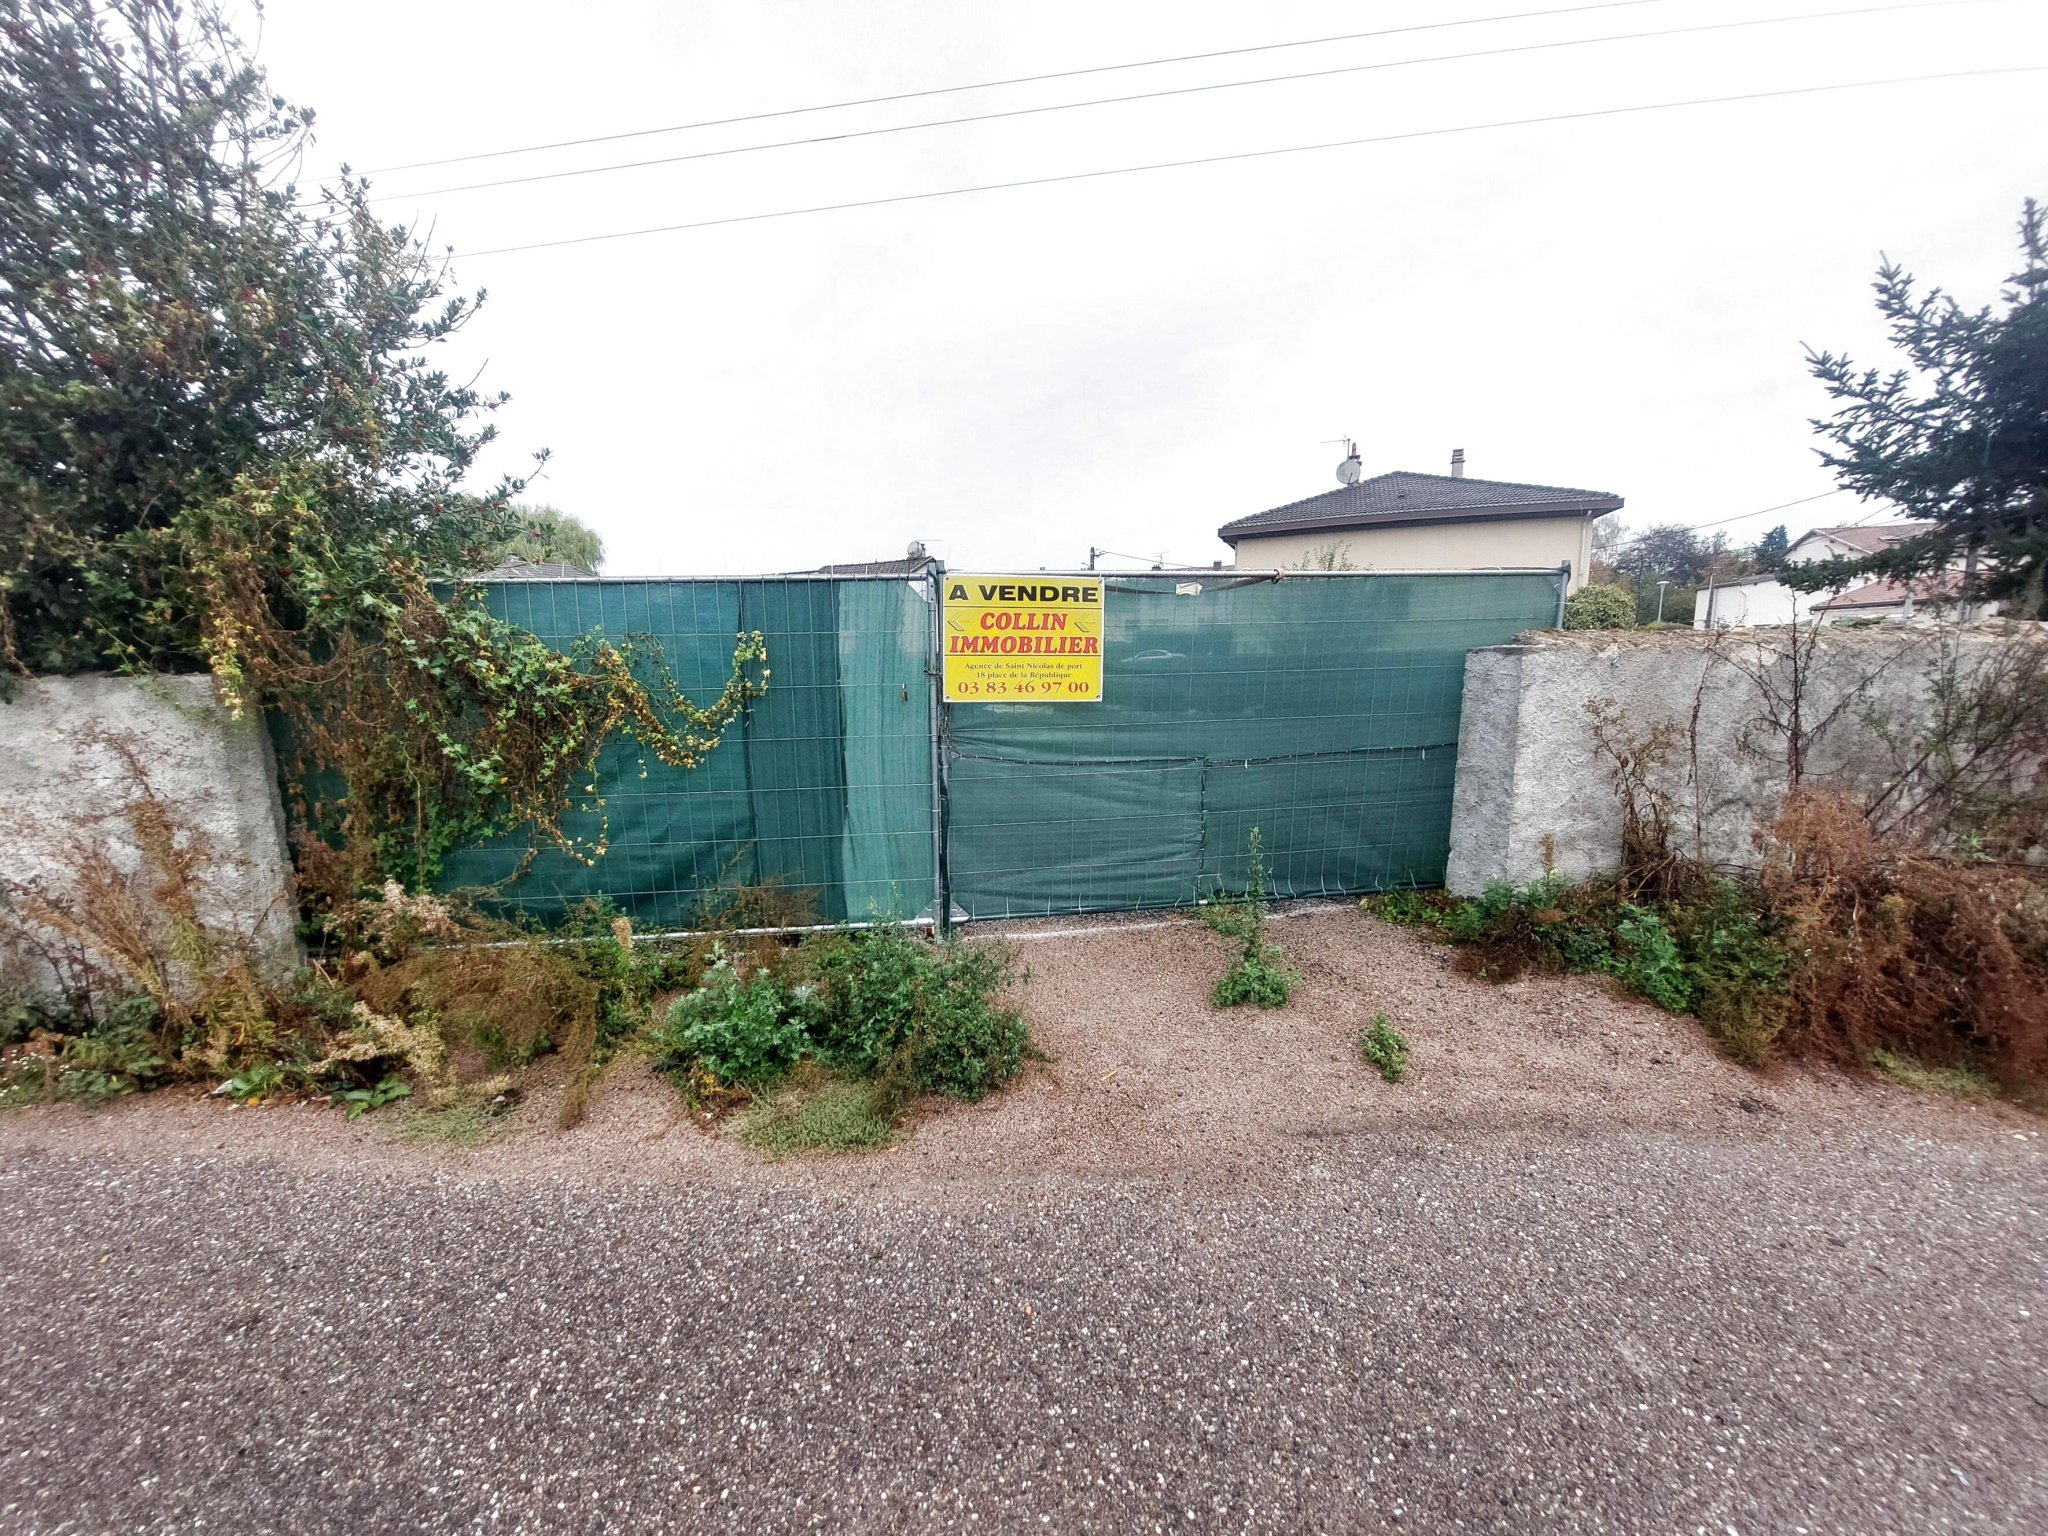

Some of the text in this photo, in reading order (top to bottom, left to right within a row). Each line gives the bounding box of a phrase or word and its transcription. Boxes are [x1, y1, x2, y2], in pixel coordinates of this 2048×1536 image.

[949, 585, 1098, 602] A VENDRE
[980, 612, 1068, 630] COLLIN
[950, 636, 1098, 653] IMMOBILIER
[958, 680, 1089, 694] 03 83 46 97 00
